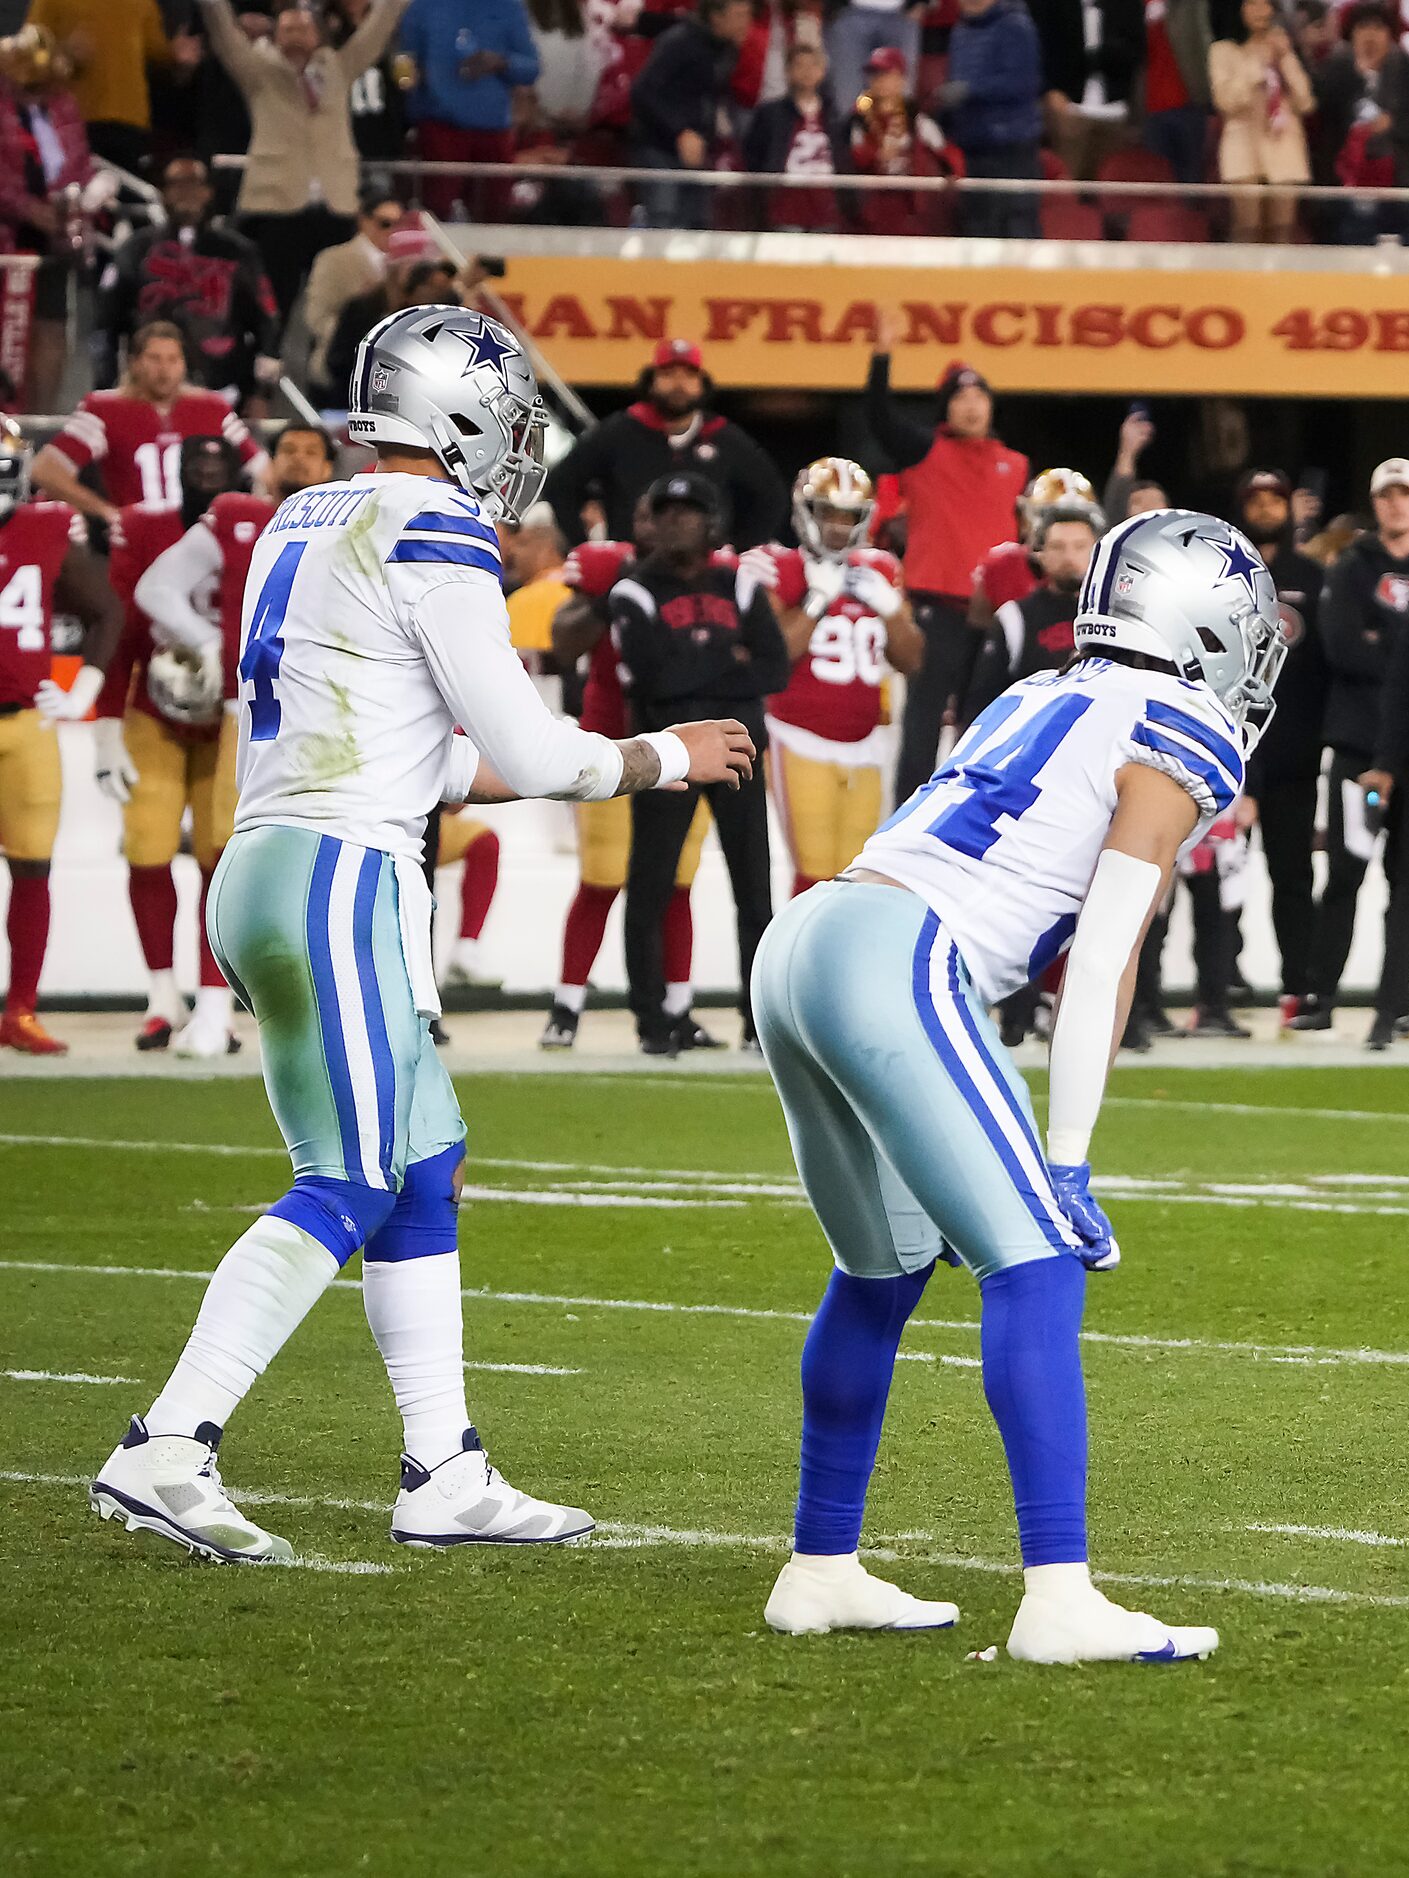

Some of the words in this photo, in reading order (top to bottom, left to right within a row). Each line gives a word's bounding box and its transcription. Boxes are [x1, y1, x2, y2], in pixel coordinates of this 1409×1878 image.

[702, 297, 1247, 351] FRANCISCO
[238, 540, 309, 742] 4
[807, 614, 889, 687] 90
